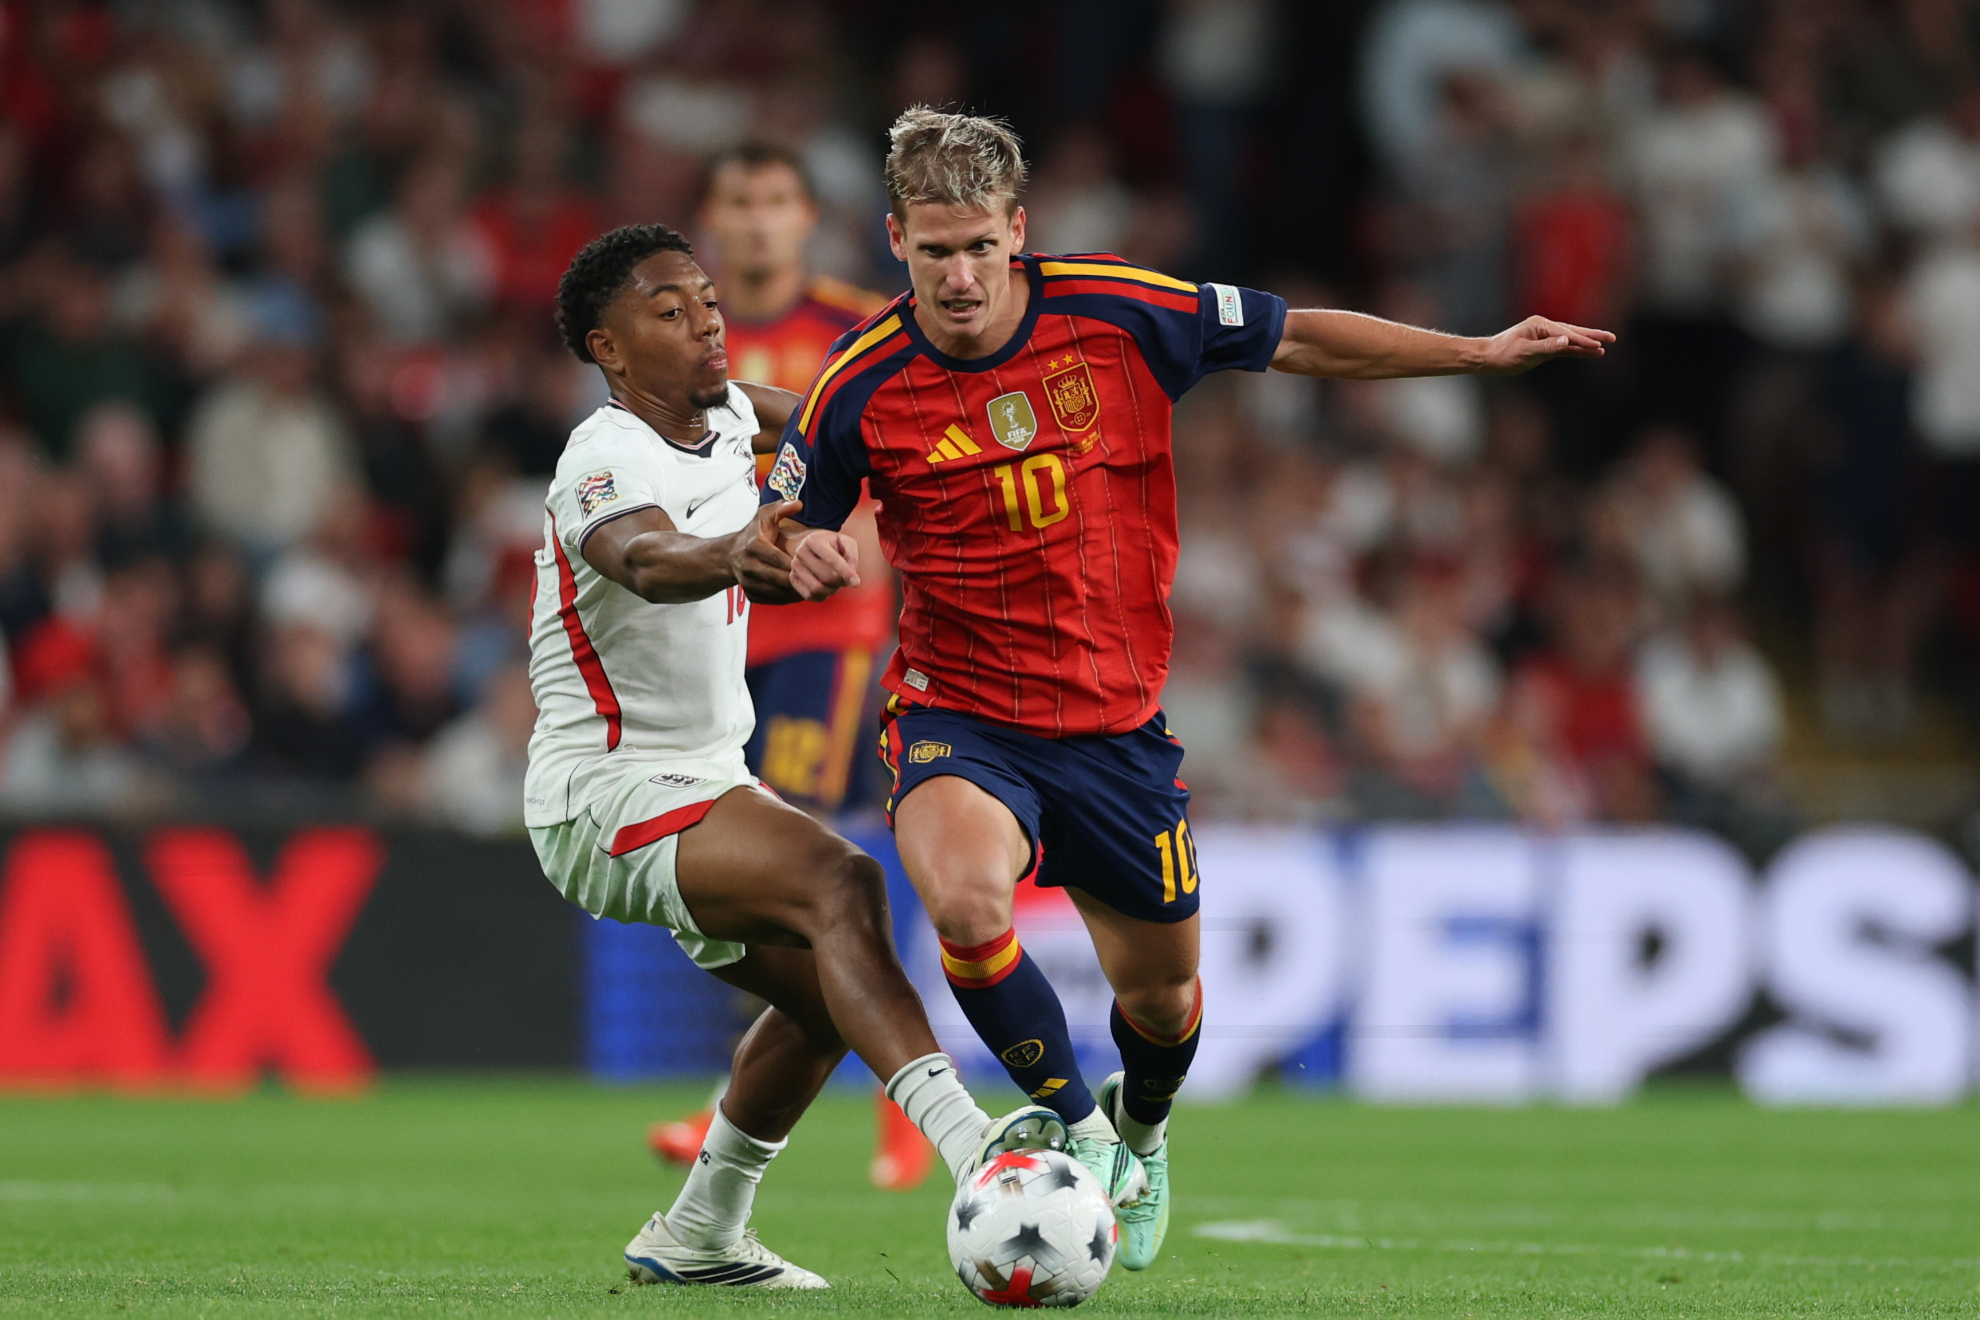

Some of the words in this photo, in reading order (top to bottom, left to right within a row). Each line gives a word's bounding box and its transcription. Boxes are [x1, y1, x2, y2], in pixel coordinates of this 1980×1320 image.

[1007, 427, 1027, 440] FIFA
[993, 453, 1070, 532] 10
[1154, 817, 1198, 904] 10
[0, 826, 382, 1096] AX
[1162, 824, 1980, 1106] PEPS
